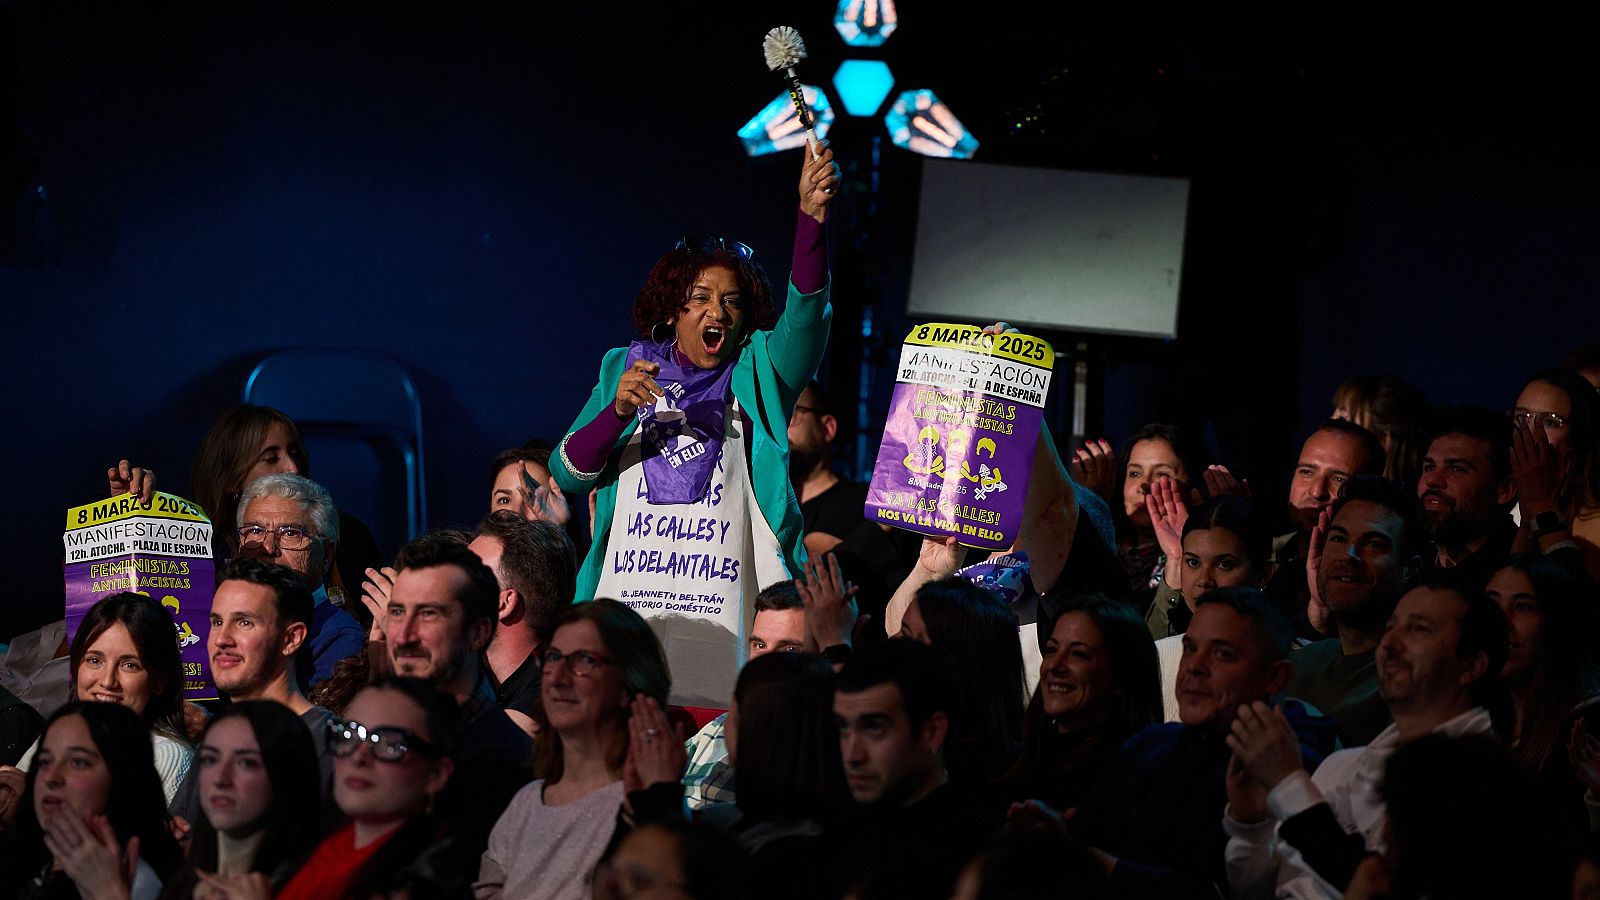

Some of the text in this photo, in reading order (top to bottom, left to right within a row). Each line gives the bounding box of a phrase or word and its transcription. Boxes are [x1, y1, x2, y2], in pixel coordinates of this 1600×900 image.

[917, 326, 1046, 361] 8 MARZO 2025
[916, 389, 1016, 420] FEMINISTAS
[993, 383, 1005, 395] DE
[1006, 386, 1042, 405] ESPAÑA
[668, 455, 683, 469] EN
[681, 442, 706, 462] ELLO
[77, 496, 200, 524] 8 MARZO 2025
[908, 496, 936, 512] LAS
[67, 522, 209, 547] MANIFESTACIÓN
[627, 511, 731, 545] LAS CALLES Y
[878, 508, 1003, 542] NOS VA LA VIDA EN ELLO
[70, 549, 89, 561] 12h.
[90, 542, 126, 558] ATOCHA
[133, 540, 160, 552] PLAZA
[162, 543, 173, 553] DE
[174, 543, 209, 556] ESPAÑA
[90, 558, 190, 579] FEMINISTAS
[614, 549, 740, 582] LOS DELANTALES
[92, 576, 191, 593] ANTIRRACISTAS
[622, 601, 722, 615] ERRITORIO DOMÉSTICO
[630, 590, 677, 601] JEANNETH
[678, 593, 725, 605] BELTRÁN
